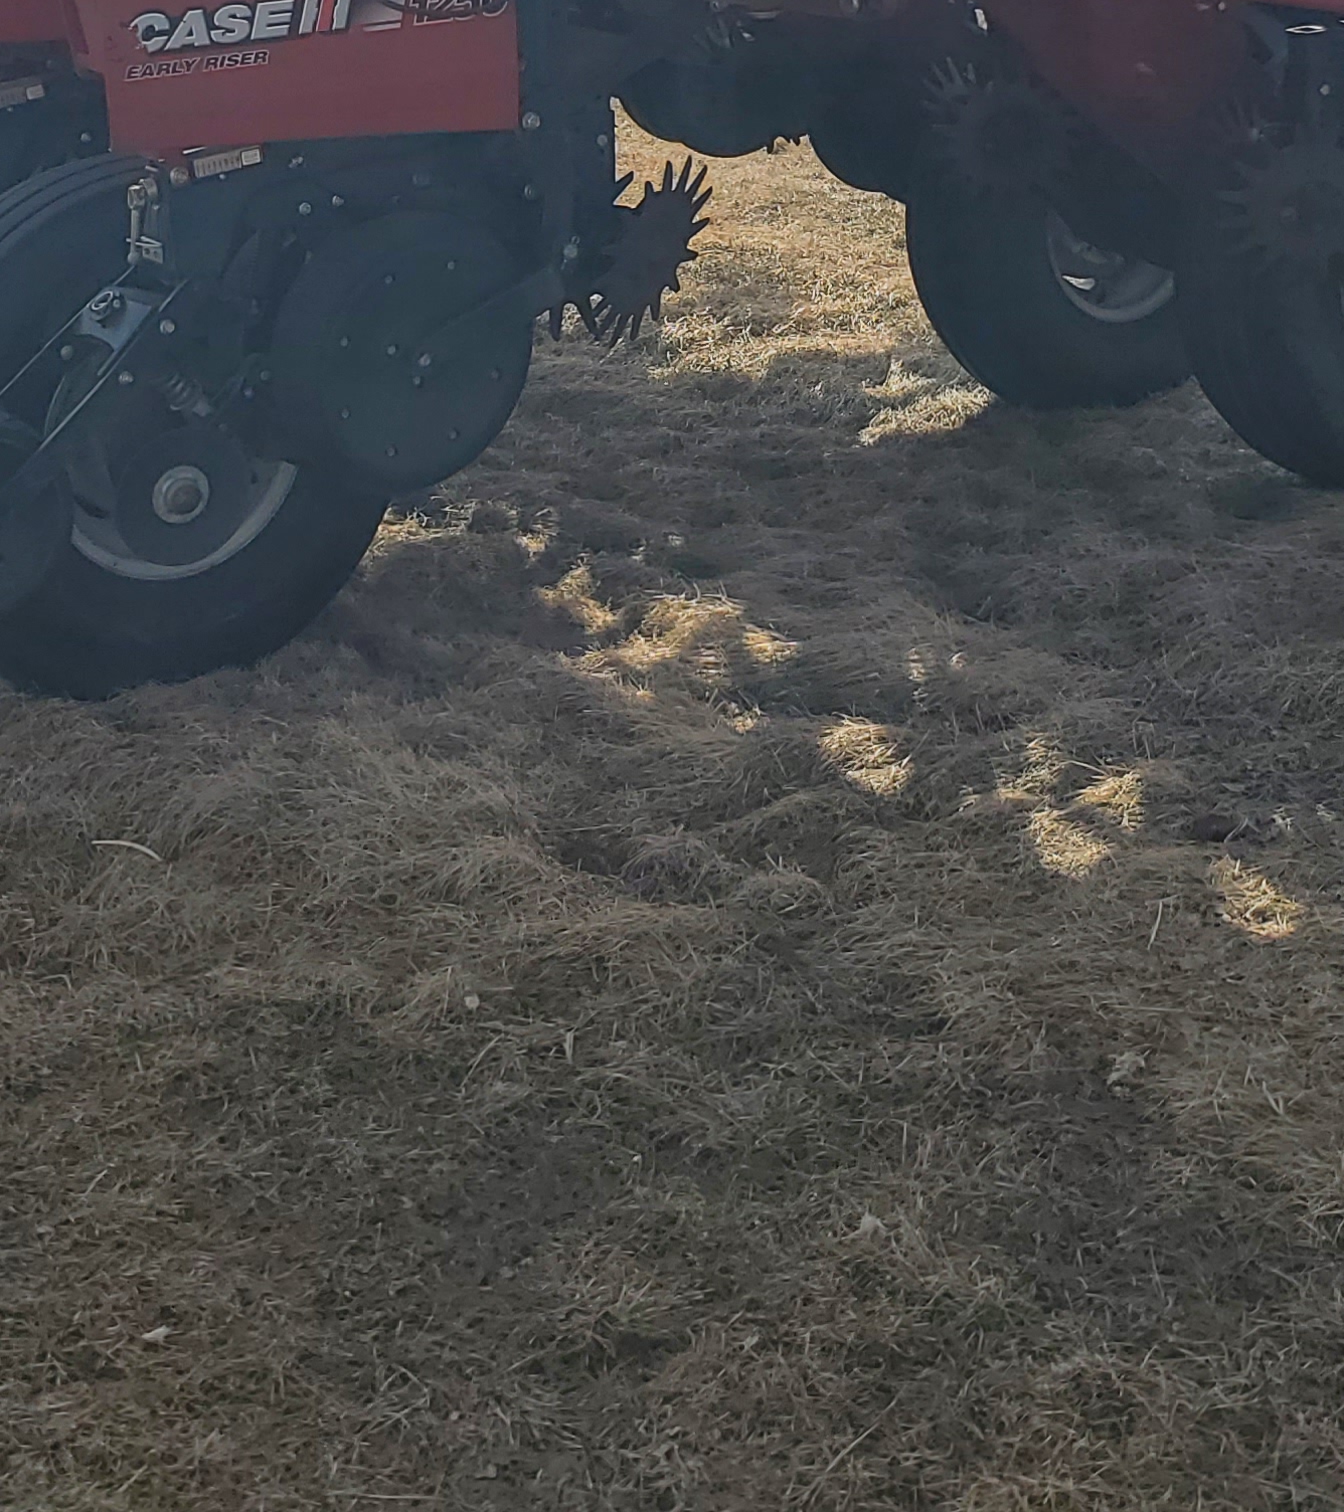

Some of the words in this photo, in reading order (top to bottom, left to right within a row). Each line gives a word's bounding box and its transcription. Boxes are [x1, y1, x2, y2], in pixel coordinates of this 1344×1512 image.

[129, 0, 294, 53] CASE
[124, 57, 199, 81] EARLY
[202, 50, 269, 71] RISER
